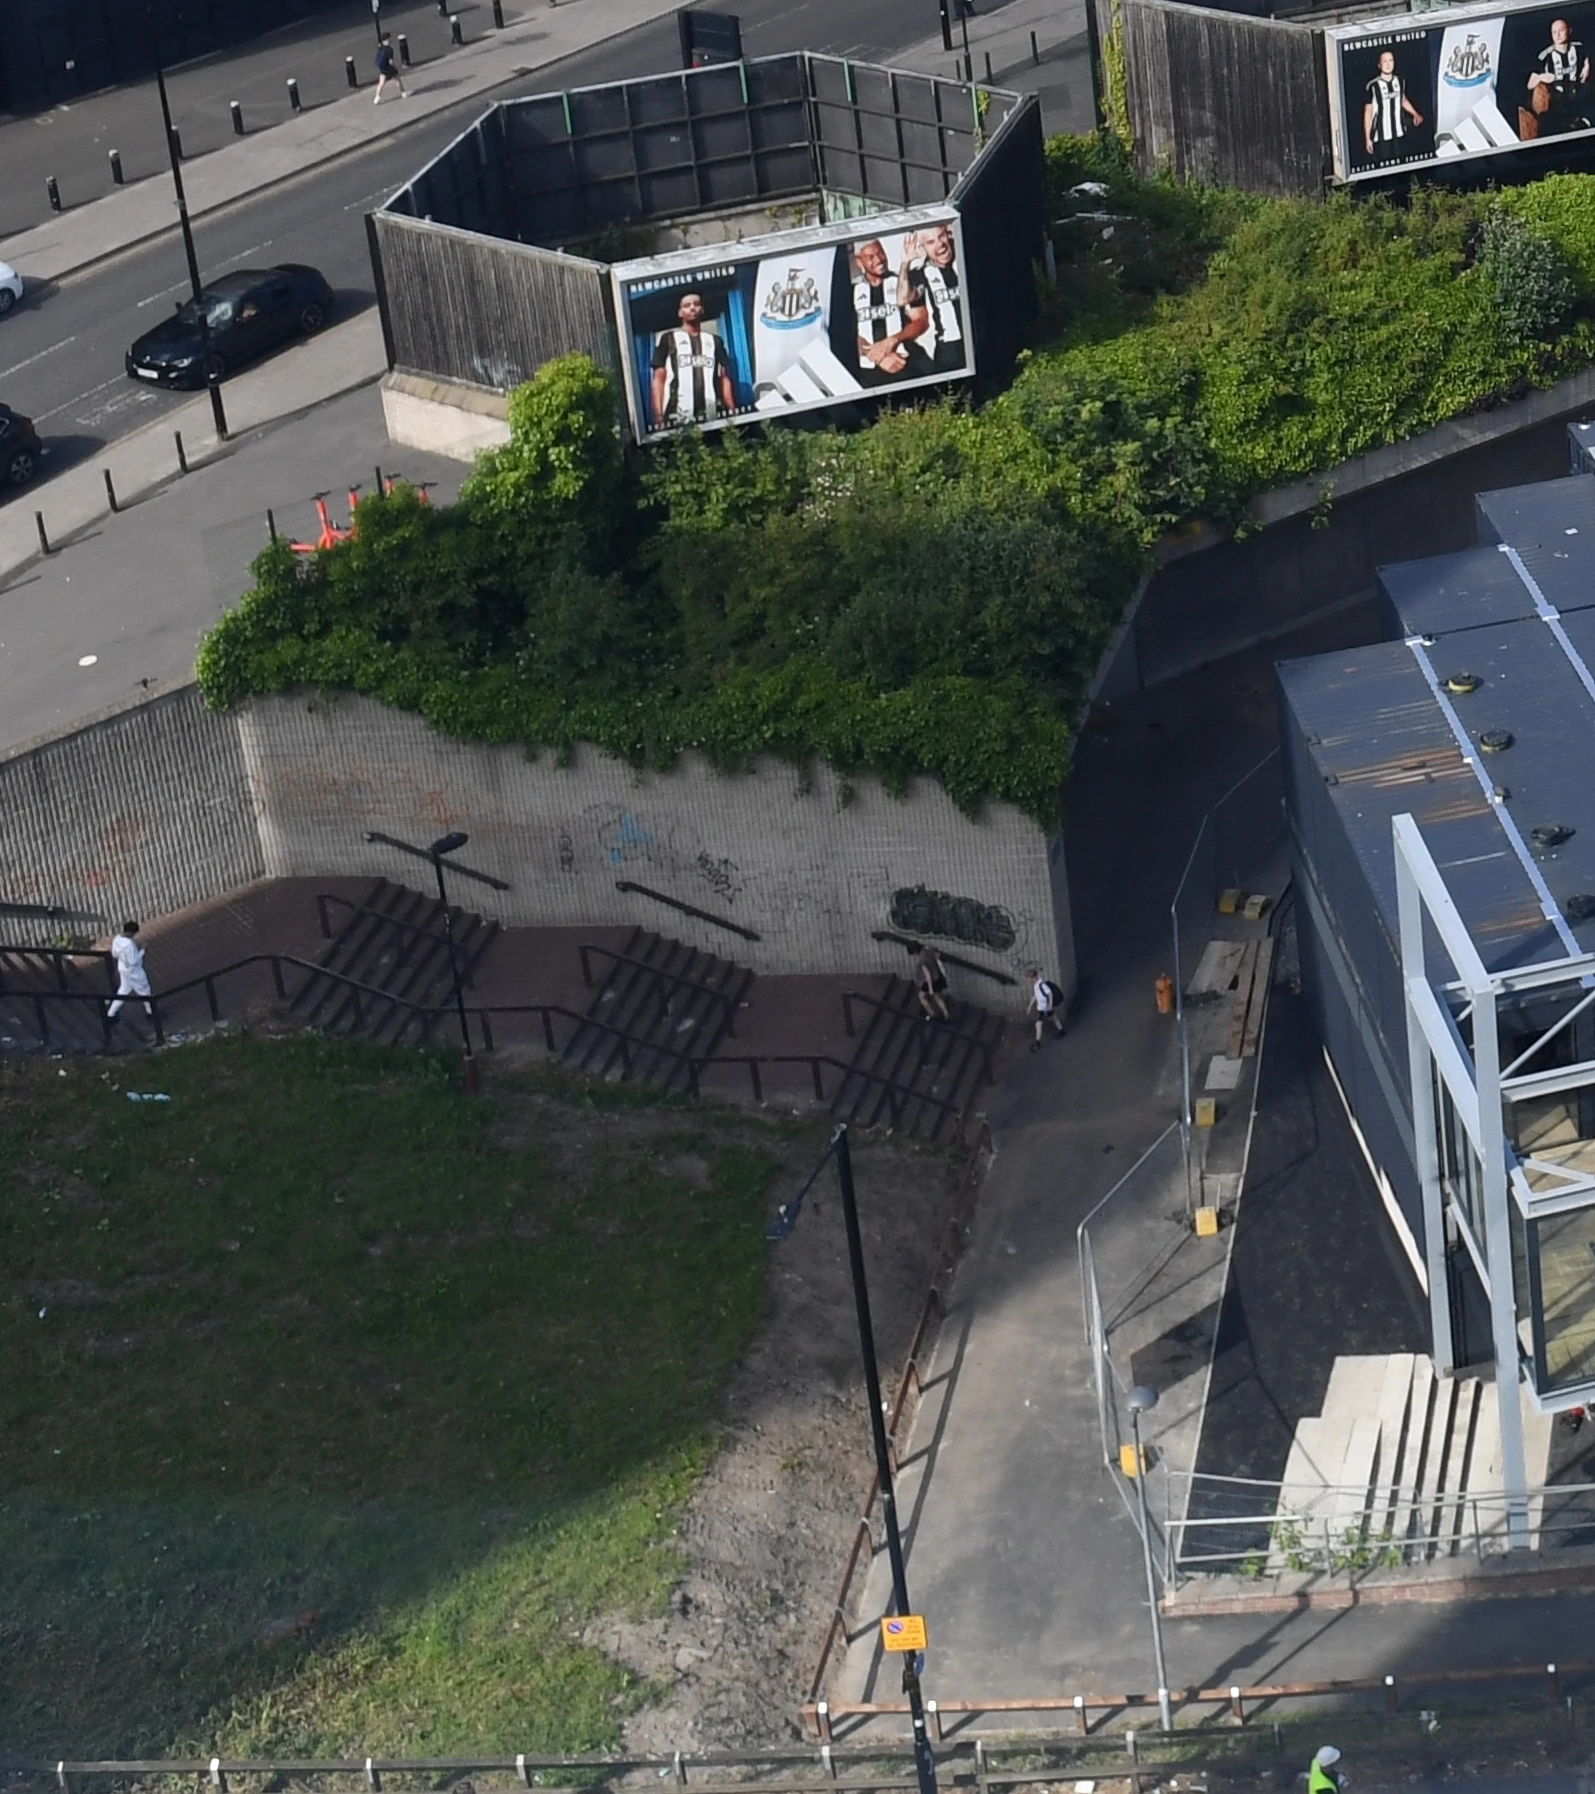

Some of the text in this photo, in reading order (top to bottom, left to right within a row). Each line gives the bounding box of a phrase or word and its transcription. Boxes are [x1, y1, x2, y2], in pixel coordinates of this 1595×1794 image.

[1343, 30, 1427, 52] NEWCASTLE UNITED
[630, 266, 736, 293] NEWCASTLE UNITED
